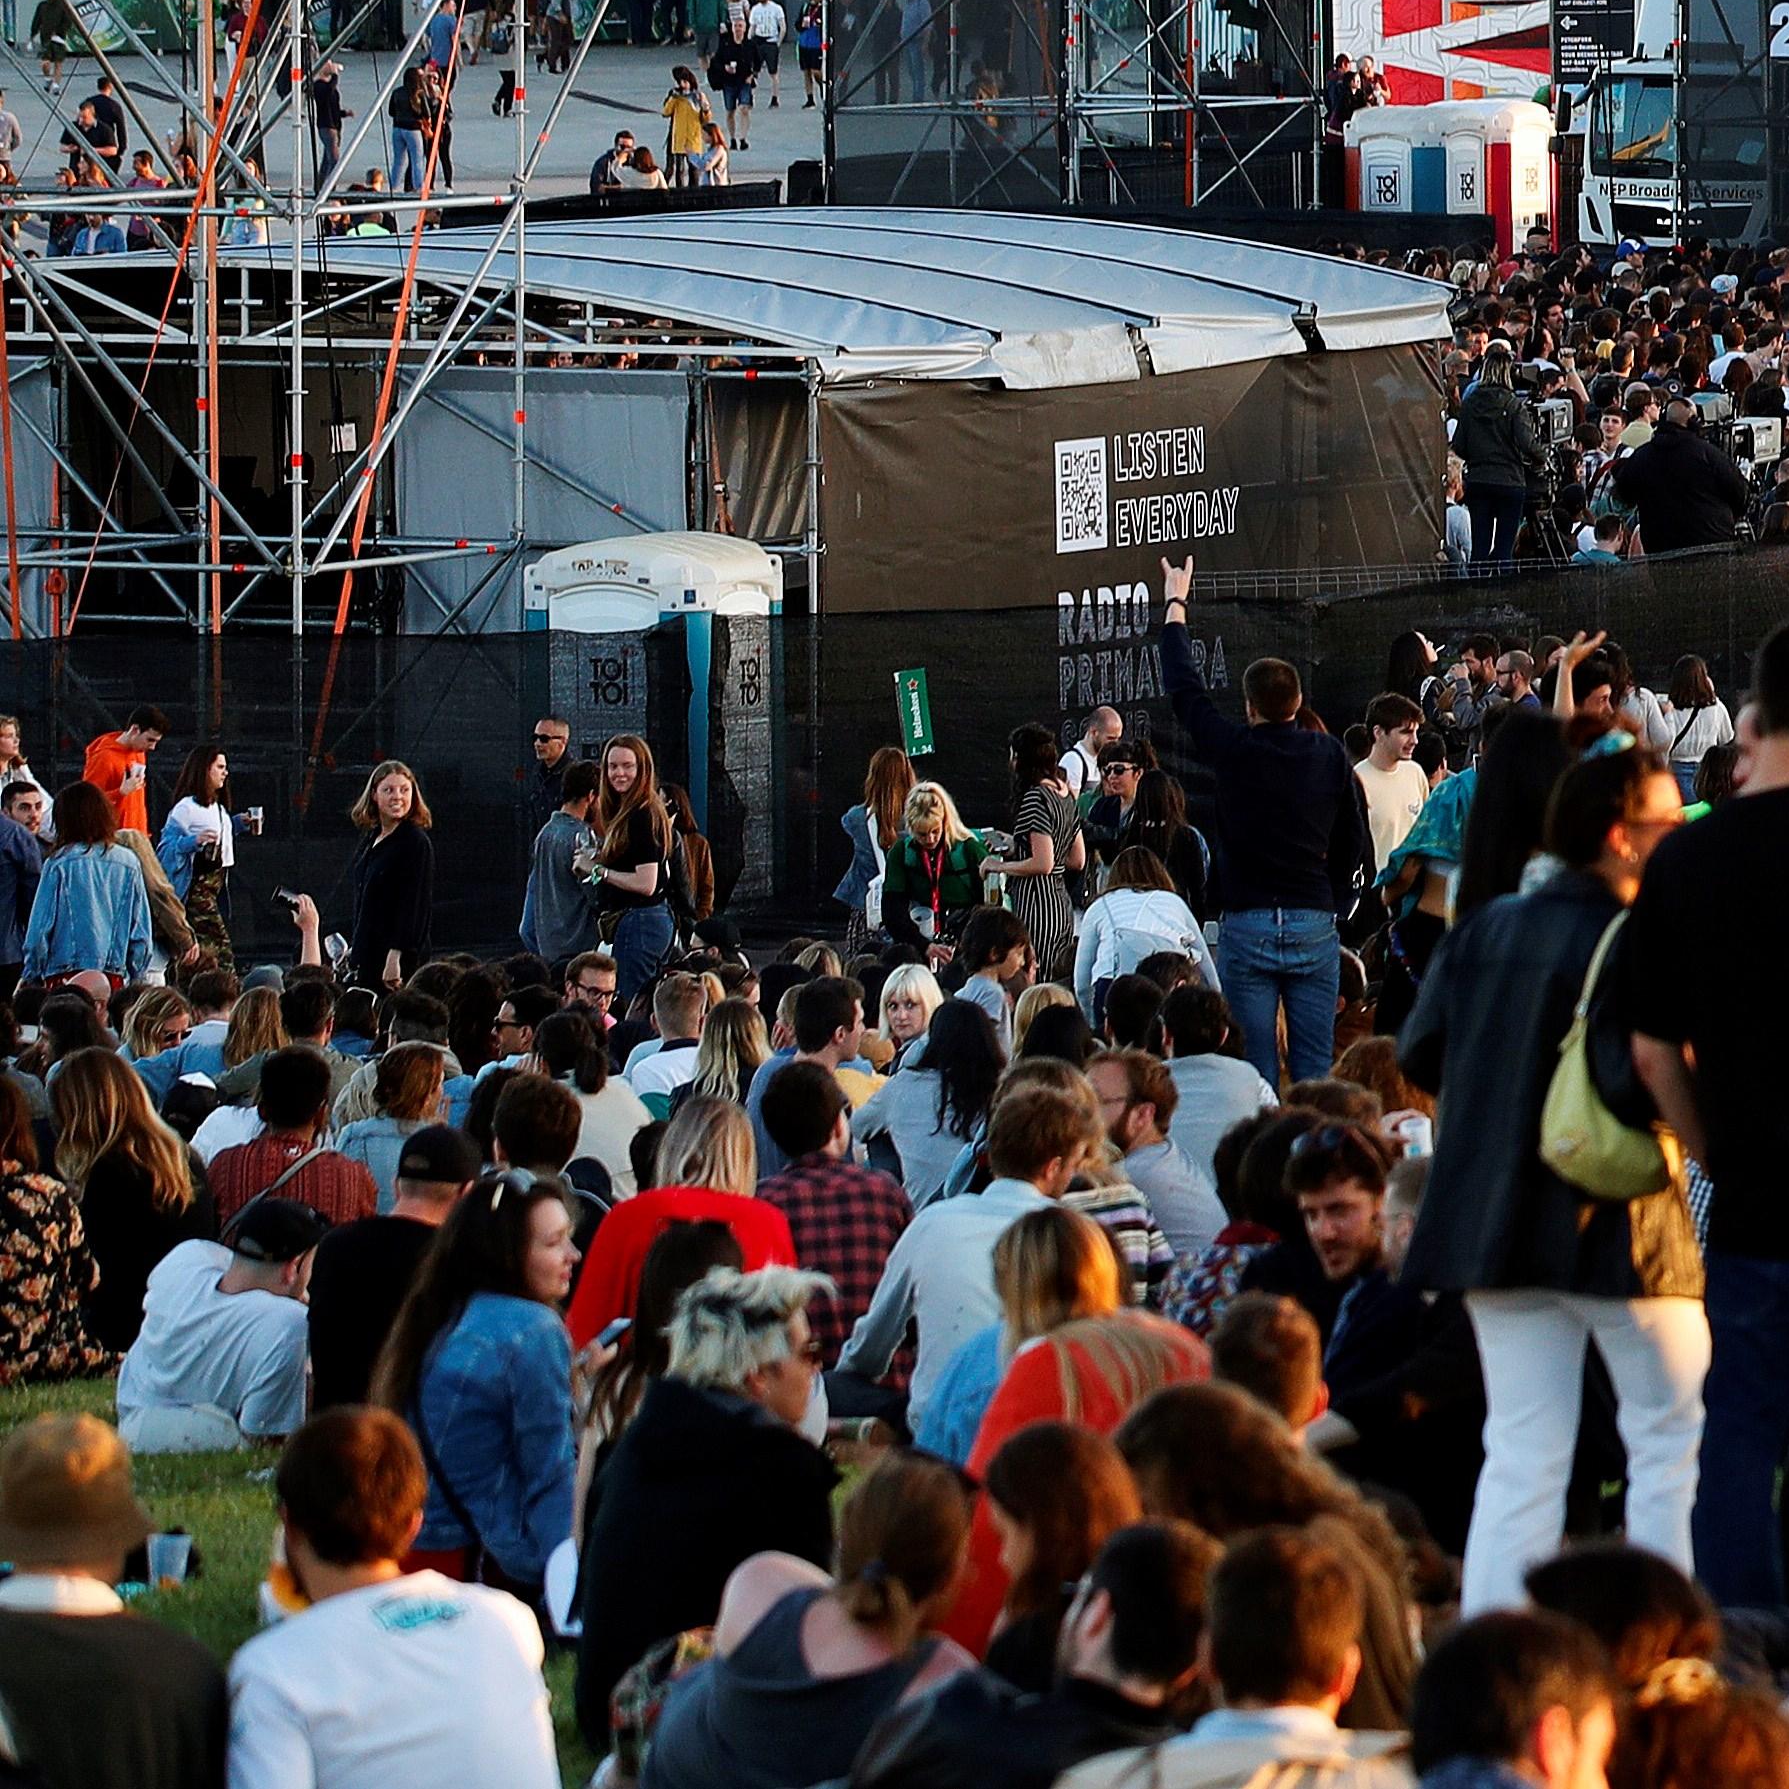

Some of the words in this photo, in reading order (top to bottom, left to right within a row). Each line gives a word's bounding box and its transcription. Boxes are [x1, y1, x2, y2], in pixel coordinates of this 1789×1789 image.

[1599, 182, 1627, 197] NEP
[1704, 184, 1764, 200] Services
[1113, 425, 1206, 483] LISTEN
[1115, 486, 1240, 548] EVERYDAY
[1056, 581, 1151, 647] RADIO
[589, 681, 628, 706] TOI
[738, 681, 762, 706] TOI
